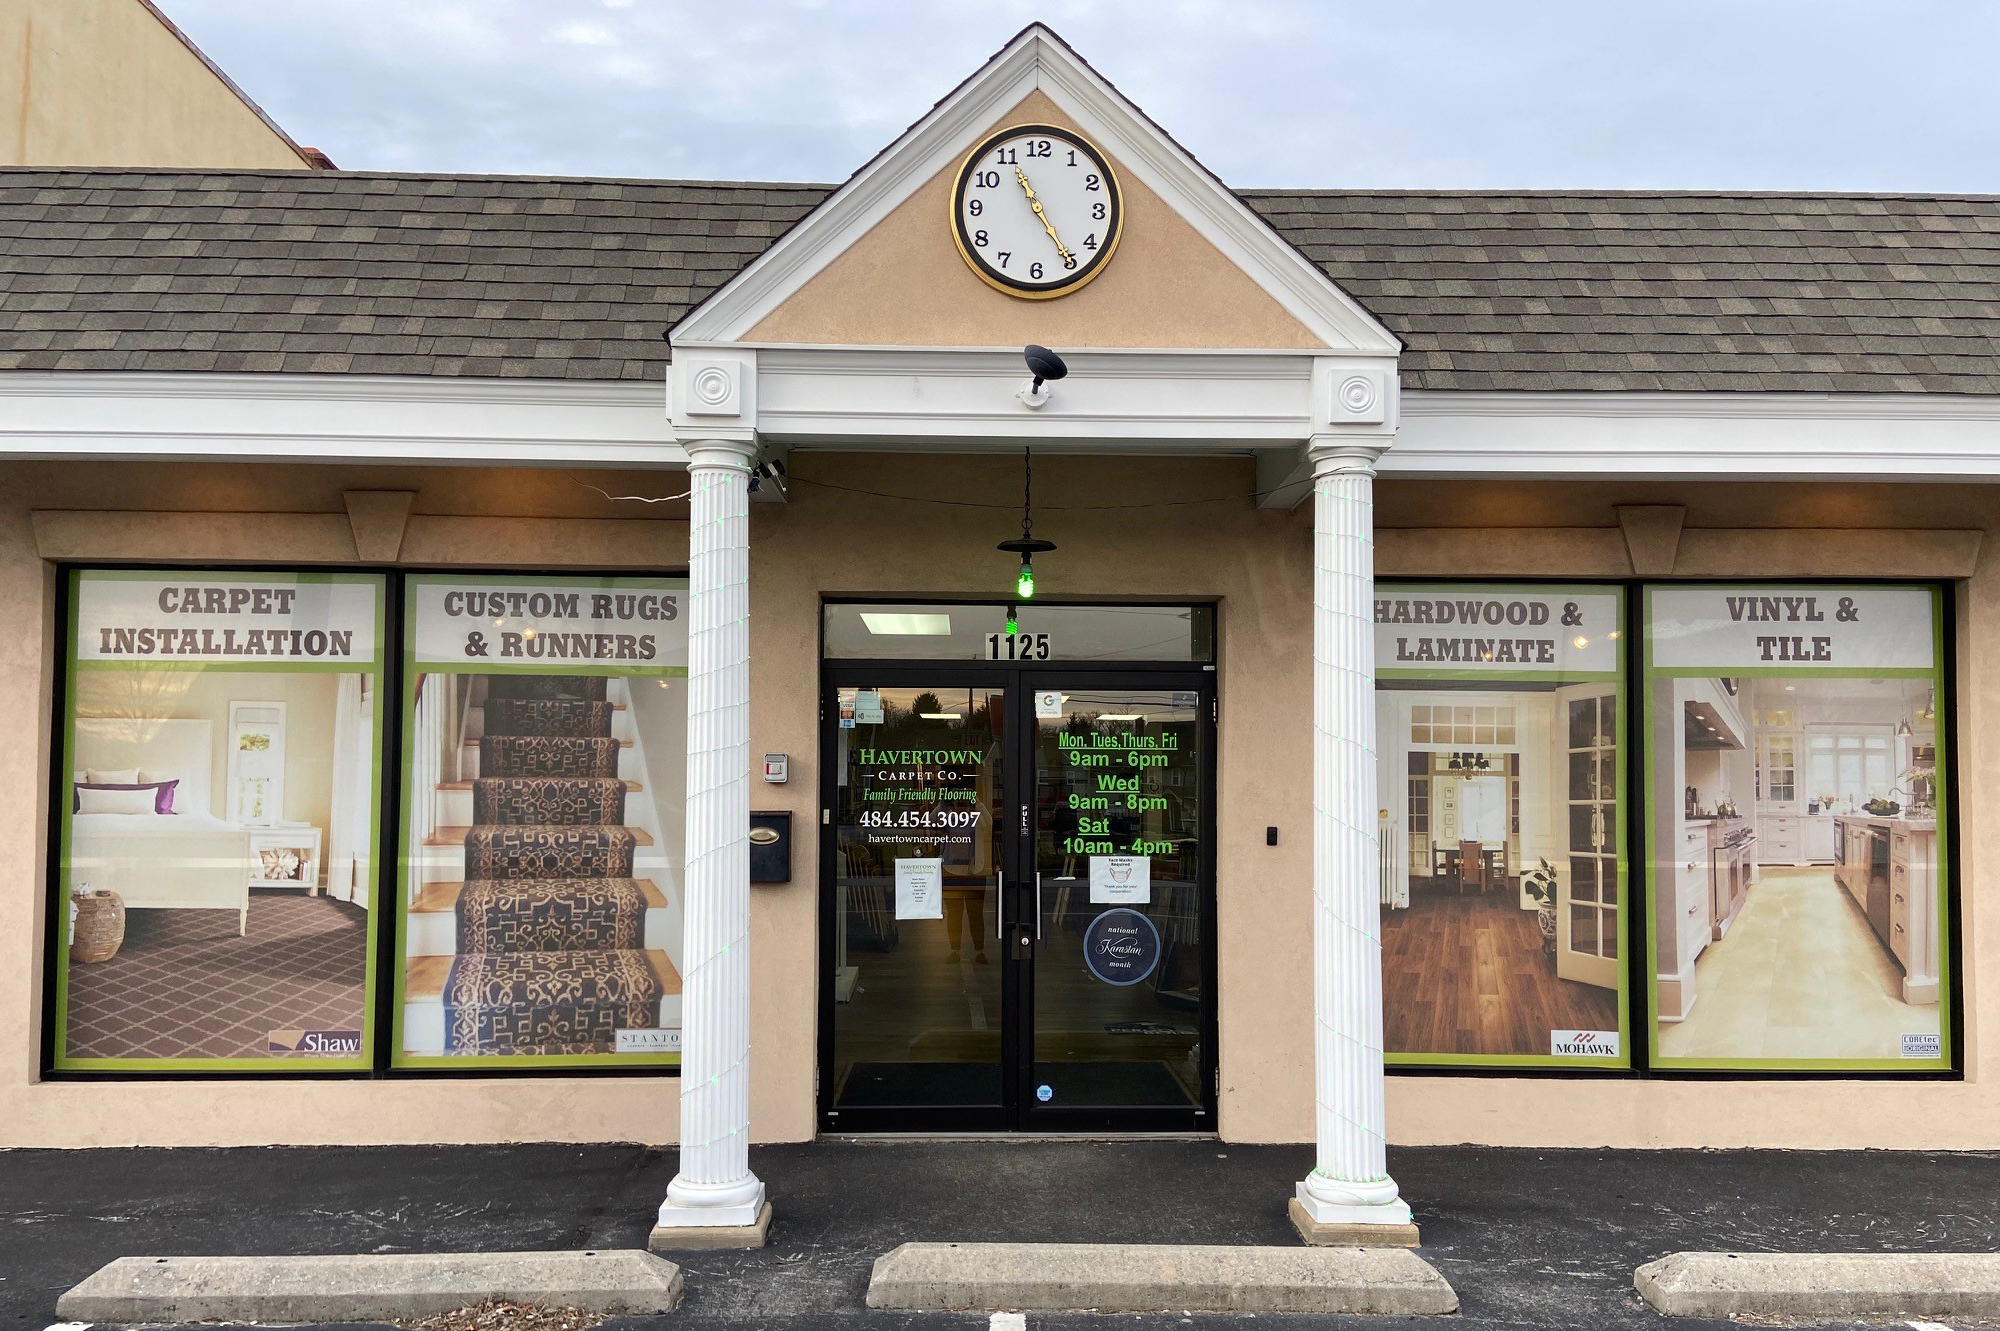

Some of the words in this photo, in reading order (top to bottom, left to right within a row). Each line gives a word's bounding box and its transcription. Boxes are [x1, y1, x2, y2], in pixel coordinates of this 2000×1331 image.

[997, 148, 1018, 165] 11
[1026, 140, 1052, 158] 12
[1067, 150, 1078, 166] 1
[976, 171, 1000, 188] 10
[1086, 174, 1100, 191] 2
[970, 200, 983, 216] 9
[1092, 203, 1106, 219] 3
[974, 230, 988, 246] 8
[1083, 234, 1097, 250] 4
[998, 252, 1012, 268] 7
[1064, 252, 1078, 270] 5
[1030, 262, 1043, 279] 6
[158, 587, 296, 614] CARPET
[444, 591, 580, 619] CUSTOM
[591, 594, 678, 622] RUGS
[1726, 597, 1824, 622] VINYL
[1835, 596, 1860, 622] &
[1374, 600, 1550, 626] HARDWOOD
[1560, 601, 1583, 626] &
[99, 628, 353, 656] INSTALLATION
[464, 631, 489, 657] &
[500, 632, 657, 660] RUNNERS
[989, 634, 1049, 660] 1125
[1396, 638, 1555, 663] LAMINATE
[1756, 636, 1832, 662] TILE
[1059, 732, 1087, 748] Mon,
[1162, 732, 1177, 748] Fri
[860, 748, 982, 764] HAVERTOWN
[1070, 750, 1109, 766] 9am
[1128, 751, 1168, 770] 6pm
[878, 770, 932, 780] CARPET
[1098, 774, 1138, 790] Wed
[863, 788, 897, 804] Family
[898, 788, 936, 804] Friendly
[938, 788, 977, 804] Flooring
[1069, 794, 1108, 810] 9am
[1127, 794, 1168, 813] 8pm
[860, 810, 981, 828] 484.454.3097
[1078, 817, 1110, 833] Sat
[868, 834, 972, 846] havertowncarpet.com
[1064, 838, 1113, 854] 10am
[1132, 838, 1172, 857] 4pm
[1095, 936, 1144, 959] Karastan
[304, 1034, 358, 1052] Shaw
[622, 1034, 679, 1042] STANTO
[1556, 1043, 1614, 1055] MOHAWK
